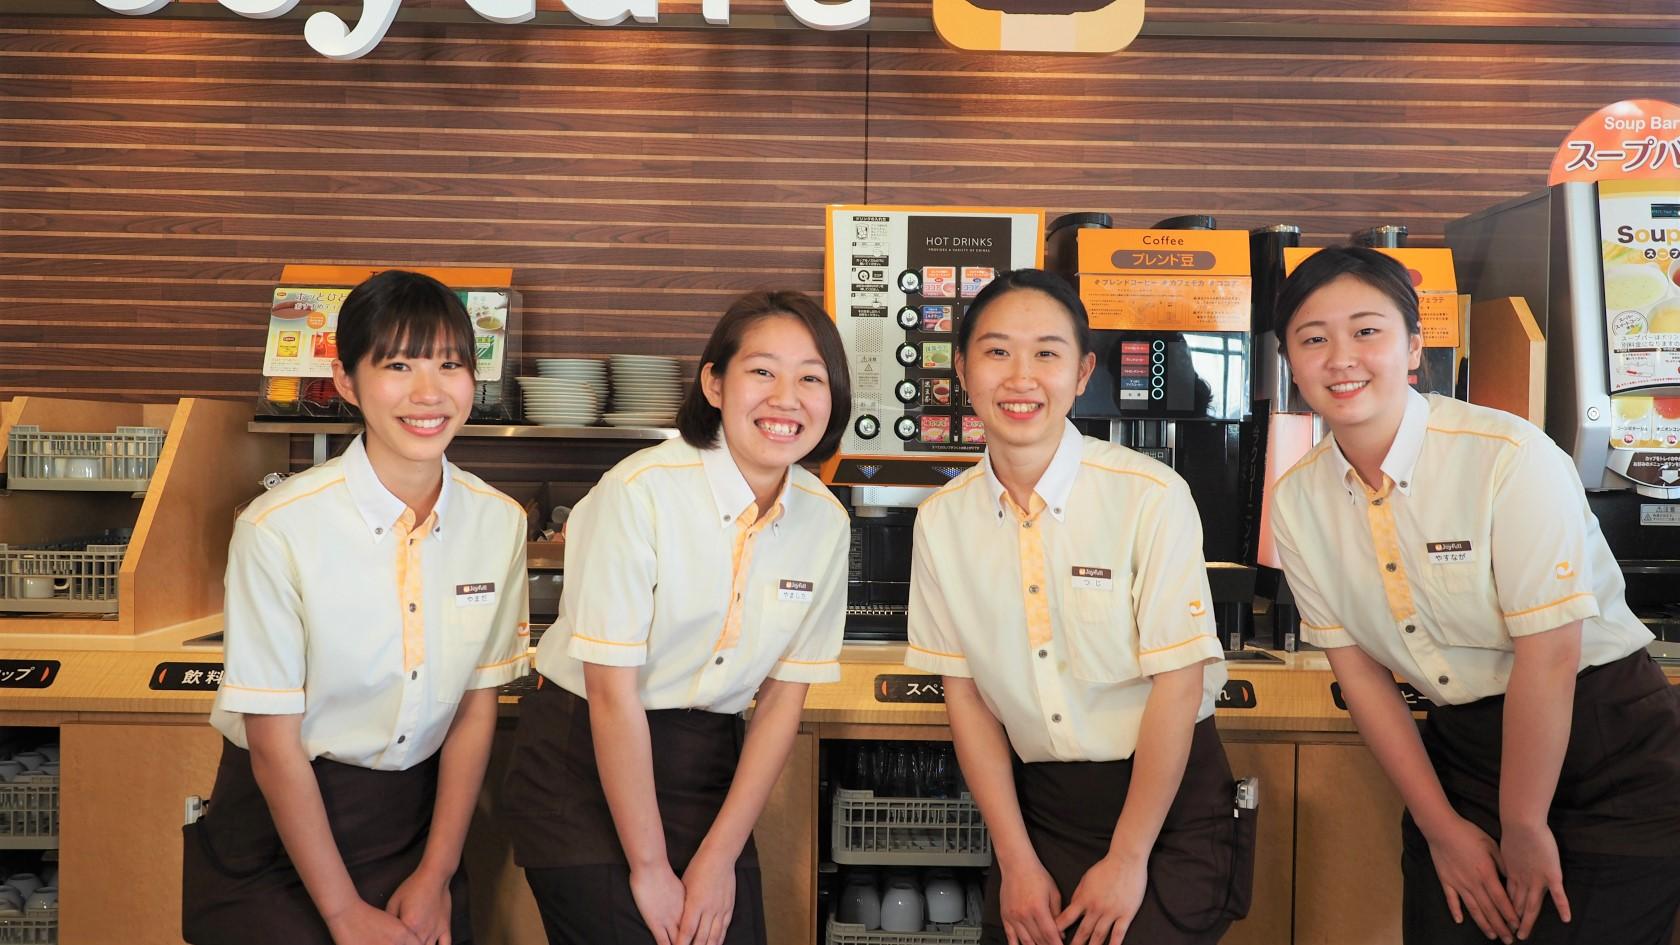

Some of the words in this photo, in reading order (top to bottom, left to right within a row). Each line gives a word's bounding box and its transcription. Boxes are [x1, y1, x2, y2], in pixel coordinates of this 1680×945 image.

[1604, 116, 1646, 132] Soup
[1650, 116, 1680, 130] Bar
[926, 236, 949, 246] HOT
[953, 237, 993, 247] DRINKS
[1142, 235, 1185, 246] Coffee
[1617, 225, 1680, 246] Soup
[1132, 253, 1195, 267] ブレンド豆
[1435, 553, 1466, 561] やすなが
[0, 666, 35, 682] ップ
